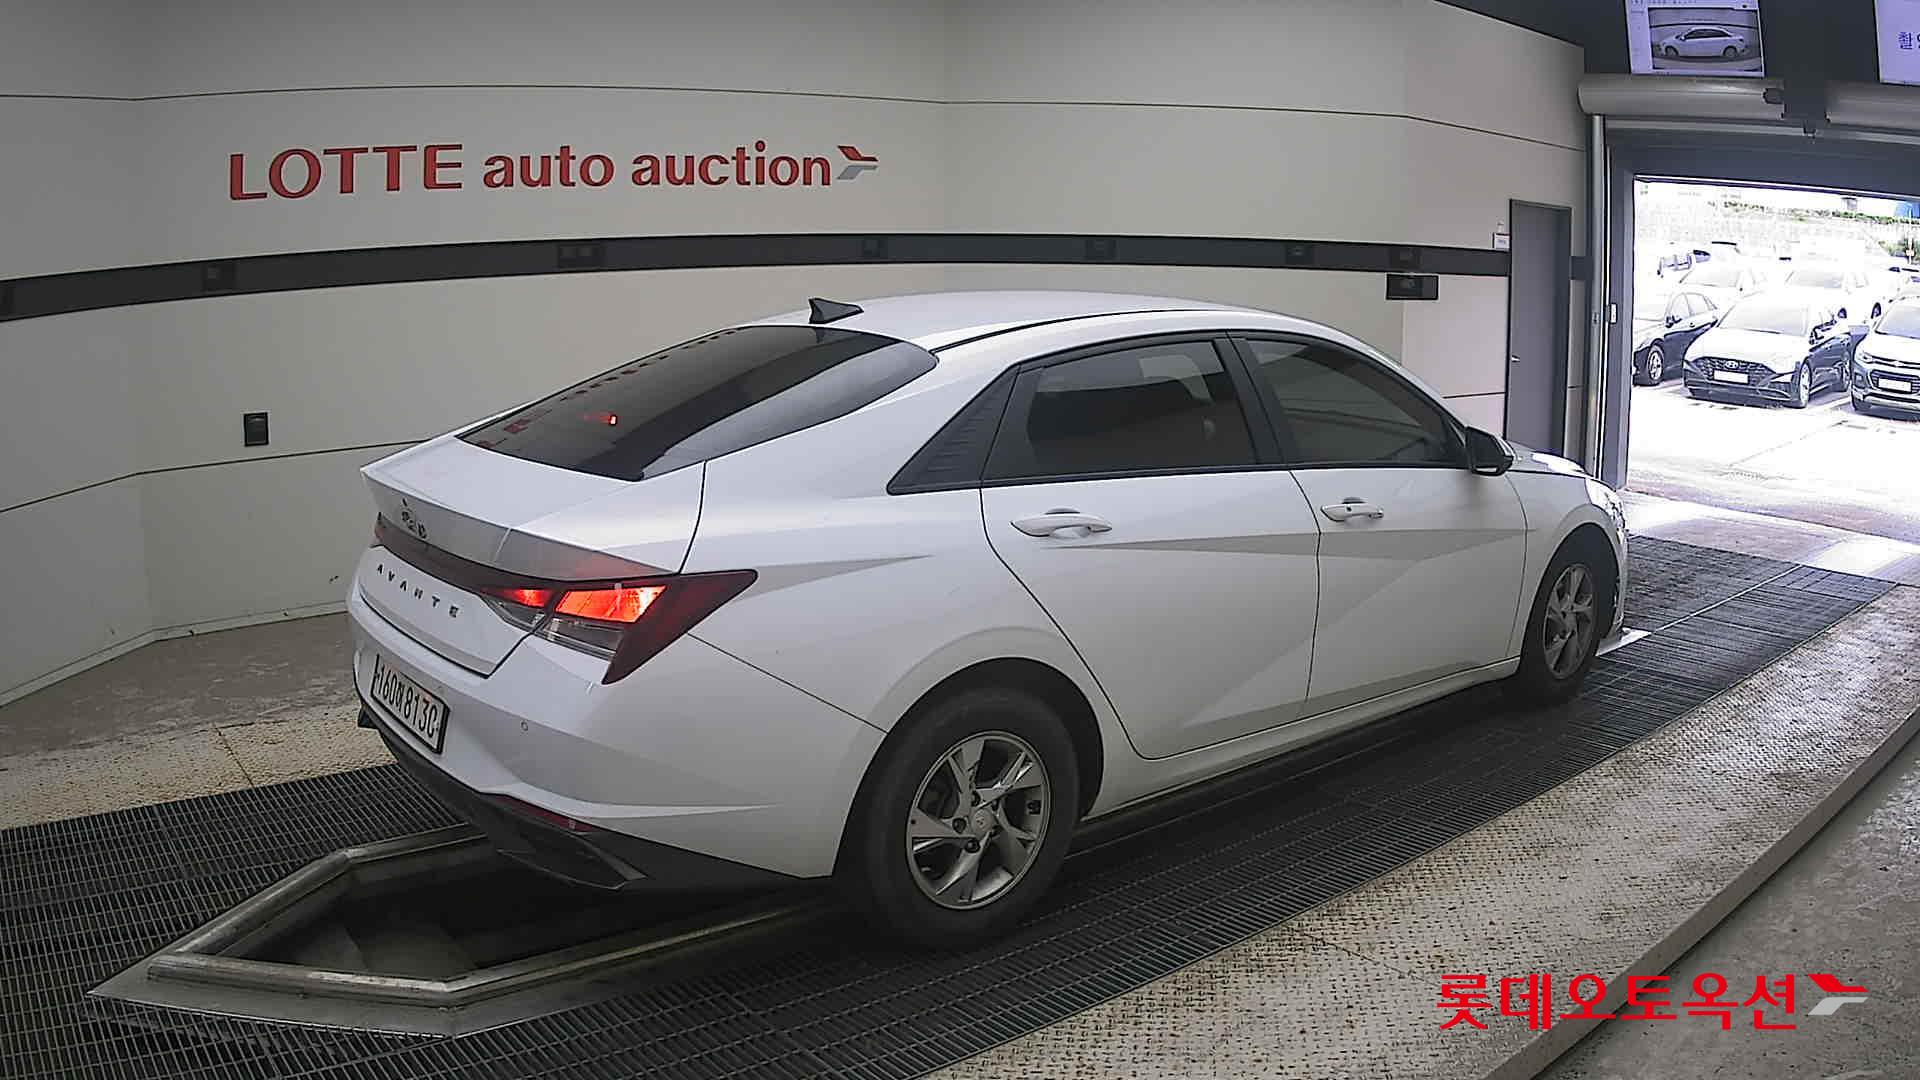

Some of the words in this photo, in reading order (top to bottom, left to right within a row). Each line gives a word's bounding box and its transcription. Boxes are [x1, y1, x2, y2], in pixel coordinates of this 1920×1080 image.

[230, 144, 463, 200] LOTTE
[483, 145, 616, 188] auto
[631, 140, 832, 187] auction
[377, 564, 459, 618] AVANTE
